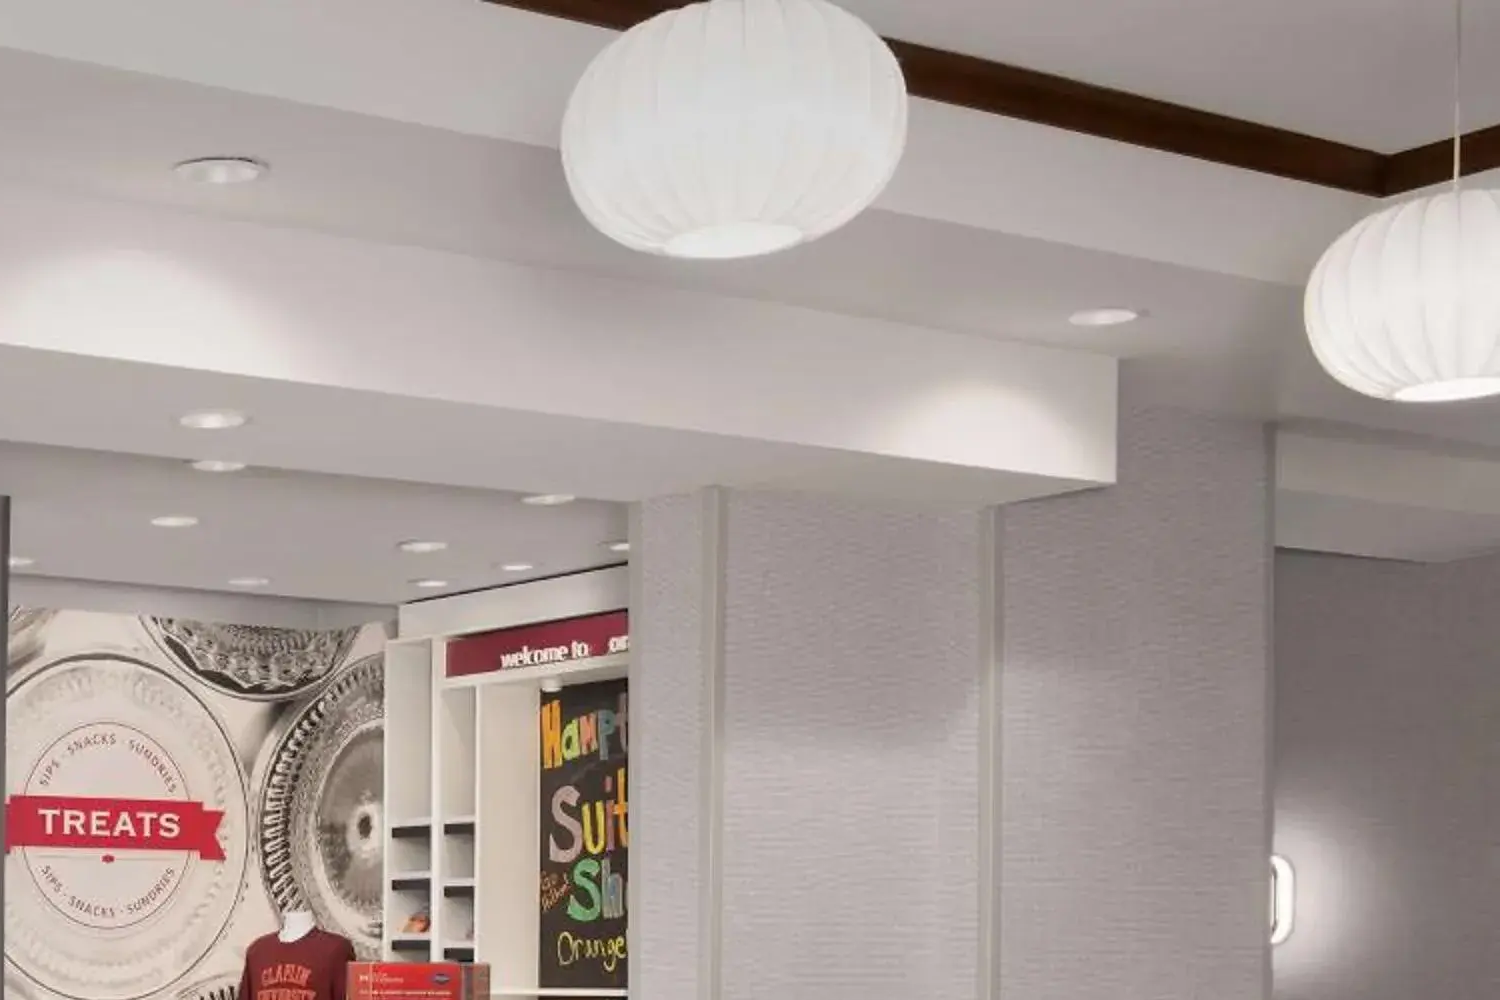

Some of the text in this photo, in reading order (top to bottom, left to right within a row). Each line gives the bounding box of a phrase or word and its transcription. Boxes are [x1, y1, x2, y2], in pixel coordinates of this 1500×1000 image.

[501, 645, 568, 668] welcome
[571, 640, 589, 659] to
[39, 733, 177, 793] SIPS SNACKS SUNDRIES
[38, 808, 181, 839] TREATS
[40, 865, 176, 917] SIPS SNACKS SUNDRIES
[567, 858, 627, 921] Sh
[557, 931, 628, 972] Orange
